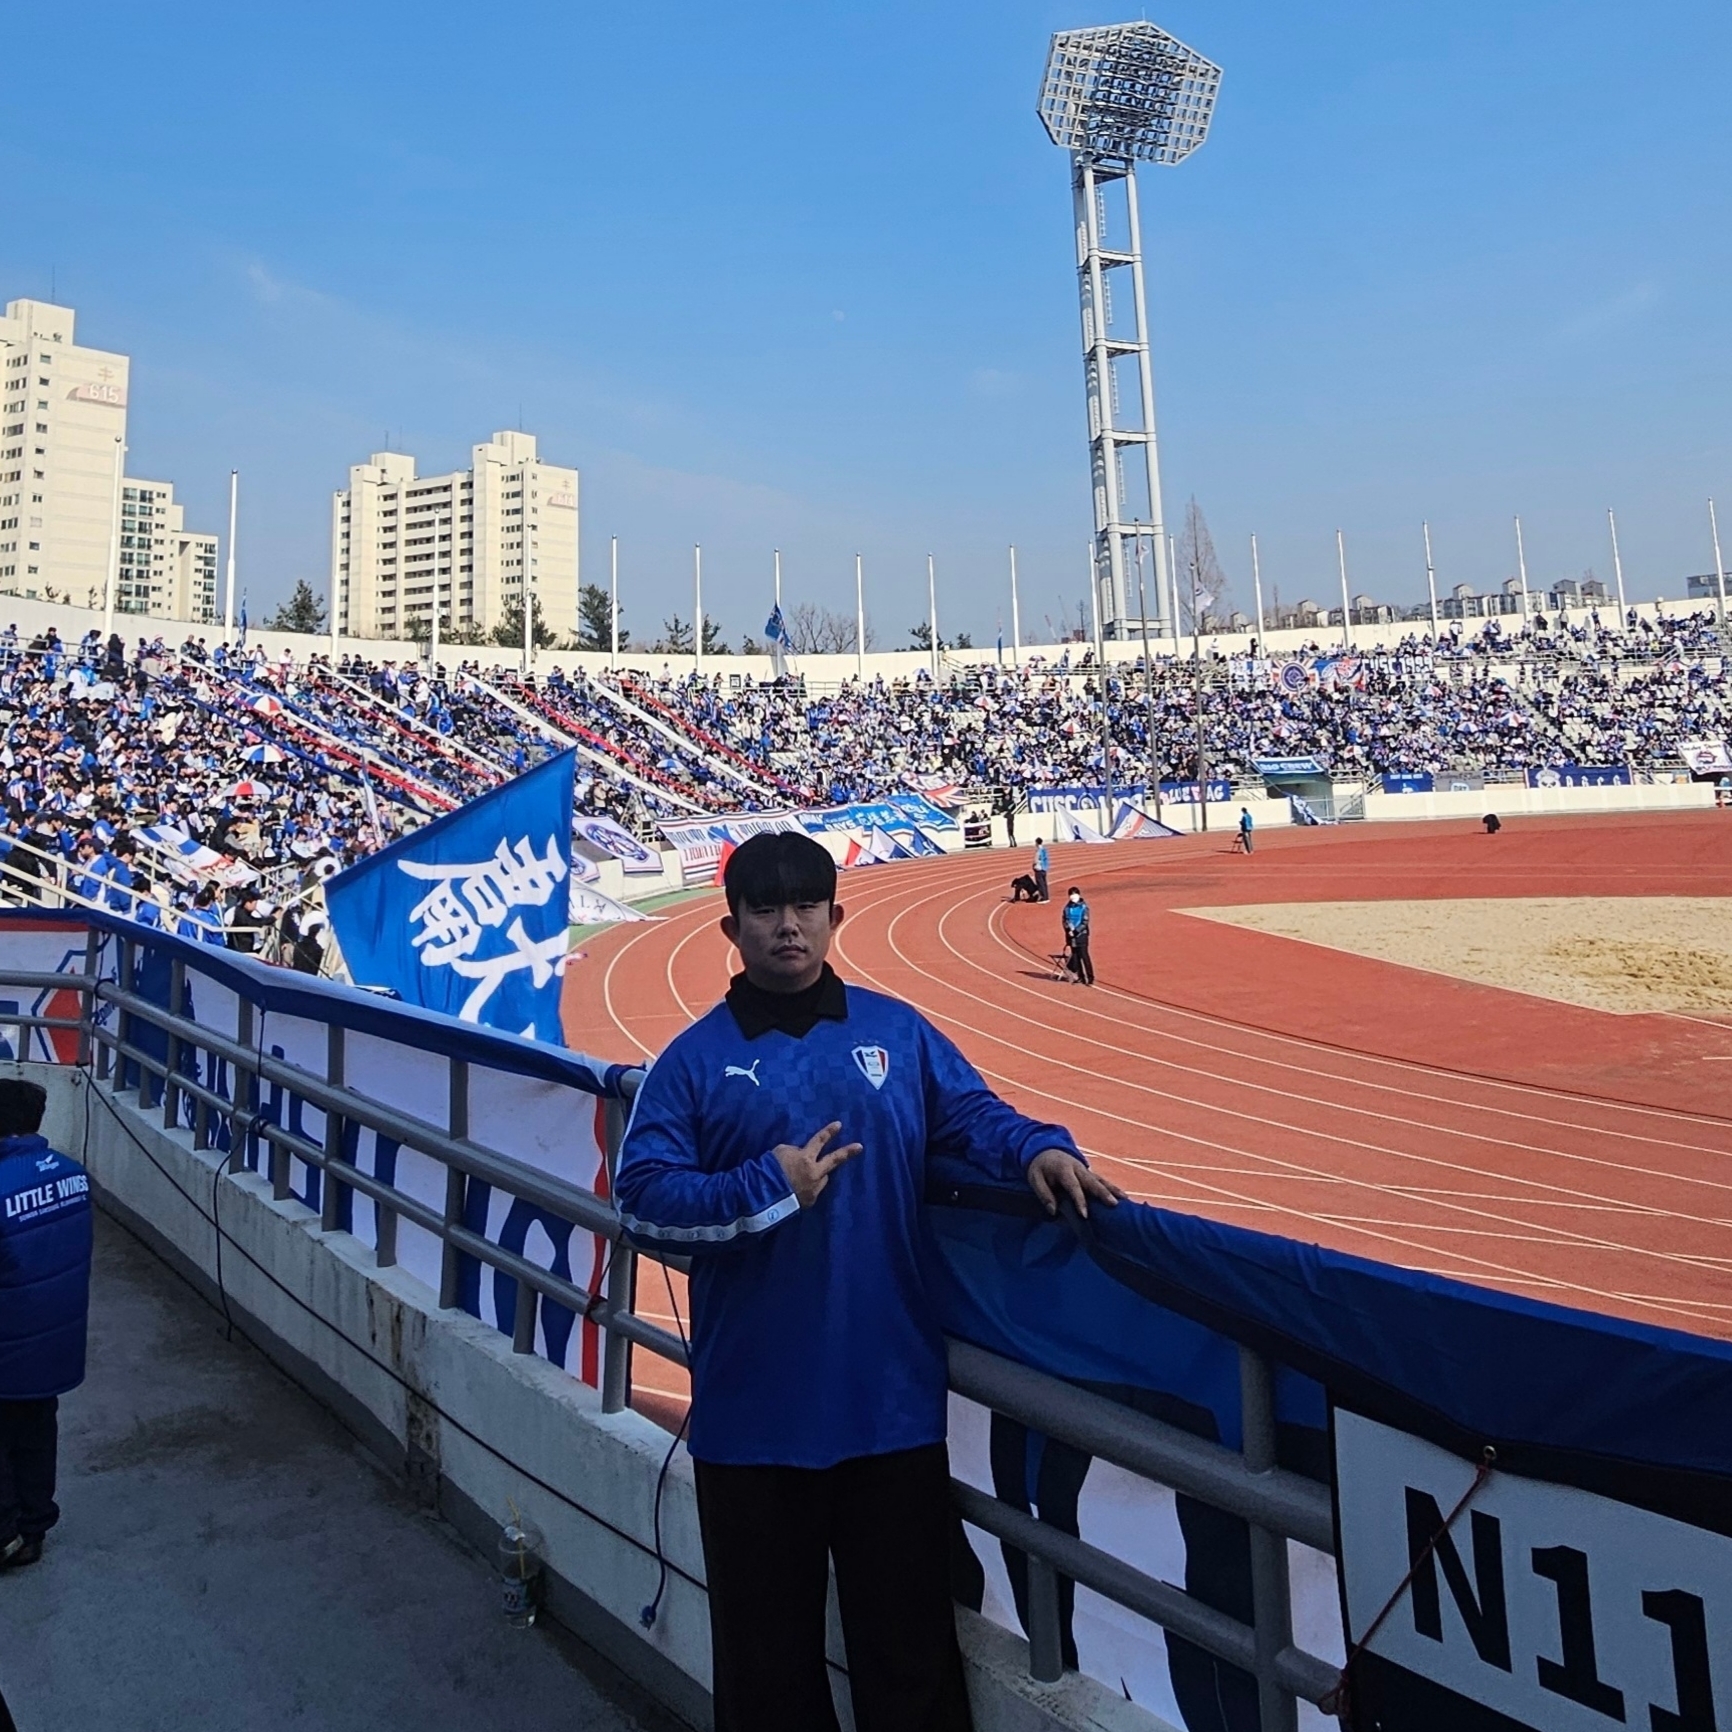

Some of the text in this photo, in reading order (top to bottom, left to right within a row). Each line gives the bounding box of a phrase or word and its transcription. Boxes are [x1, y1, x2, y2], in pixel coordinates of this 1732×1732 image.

[90, 383, 119, 403] 615
[1159, 784, 1224, 805] BLUE FAG
[397, 832, 571, 1040] 獻
[5, 1183, 54, 1218] LITTLE
[56, 1174, 89, 1199] WINGS
